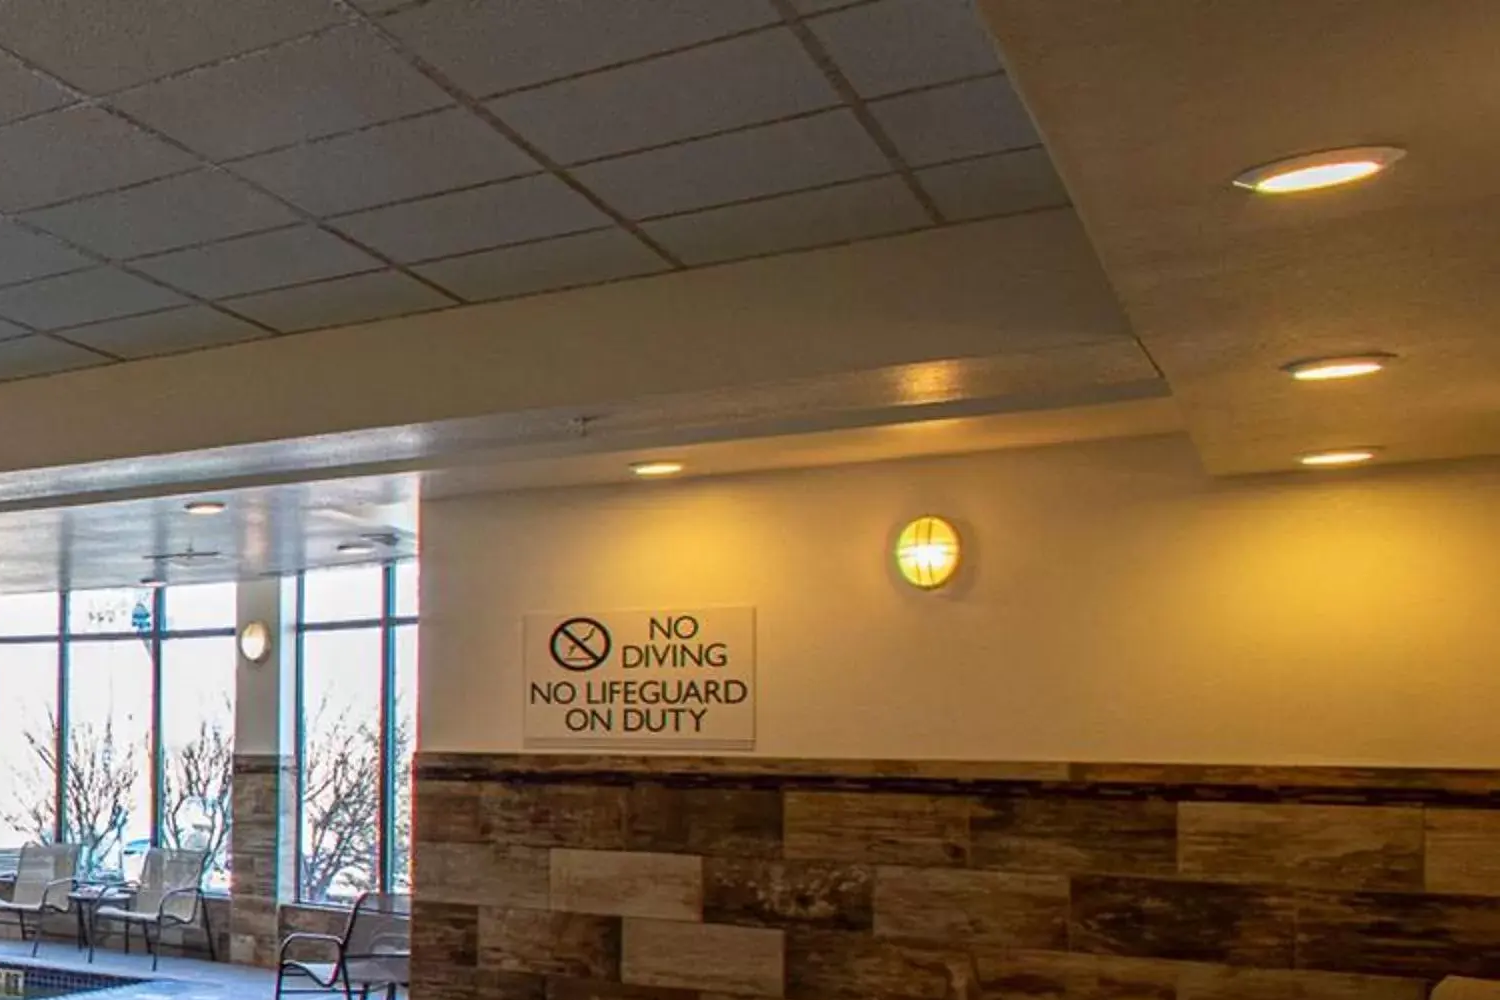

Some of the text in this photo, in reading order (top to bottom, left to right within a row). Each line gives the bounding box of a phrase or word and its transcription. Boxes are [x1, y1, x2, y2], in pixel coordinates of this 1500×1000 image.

[650, 615, 699, 640] NO
[622, 643, 727, 668] DIVING
[531, 679, 748, 705] NO LIFEGUARD
[565, 708, 707, 732] ON DUTY
